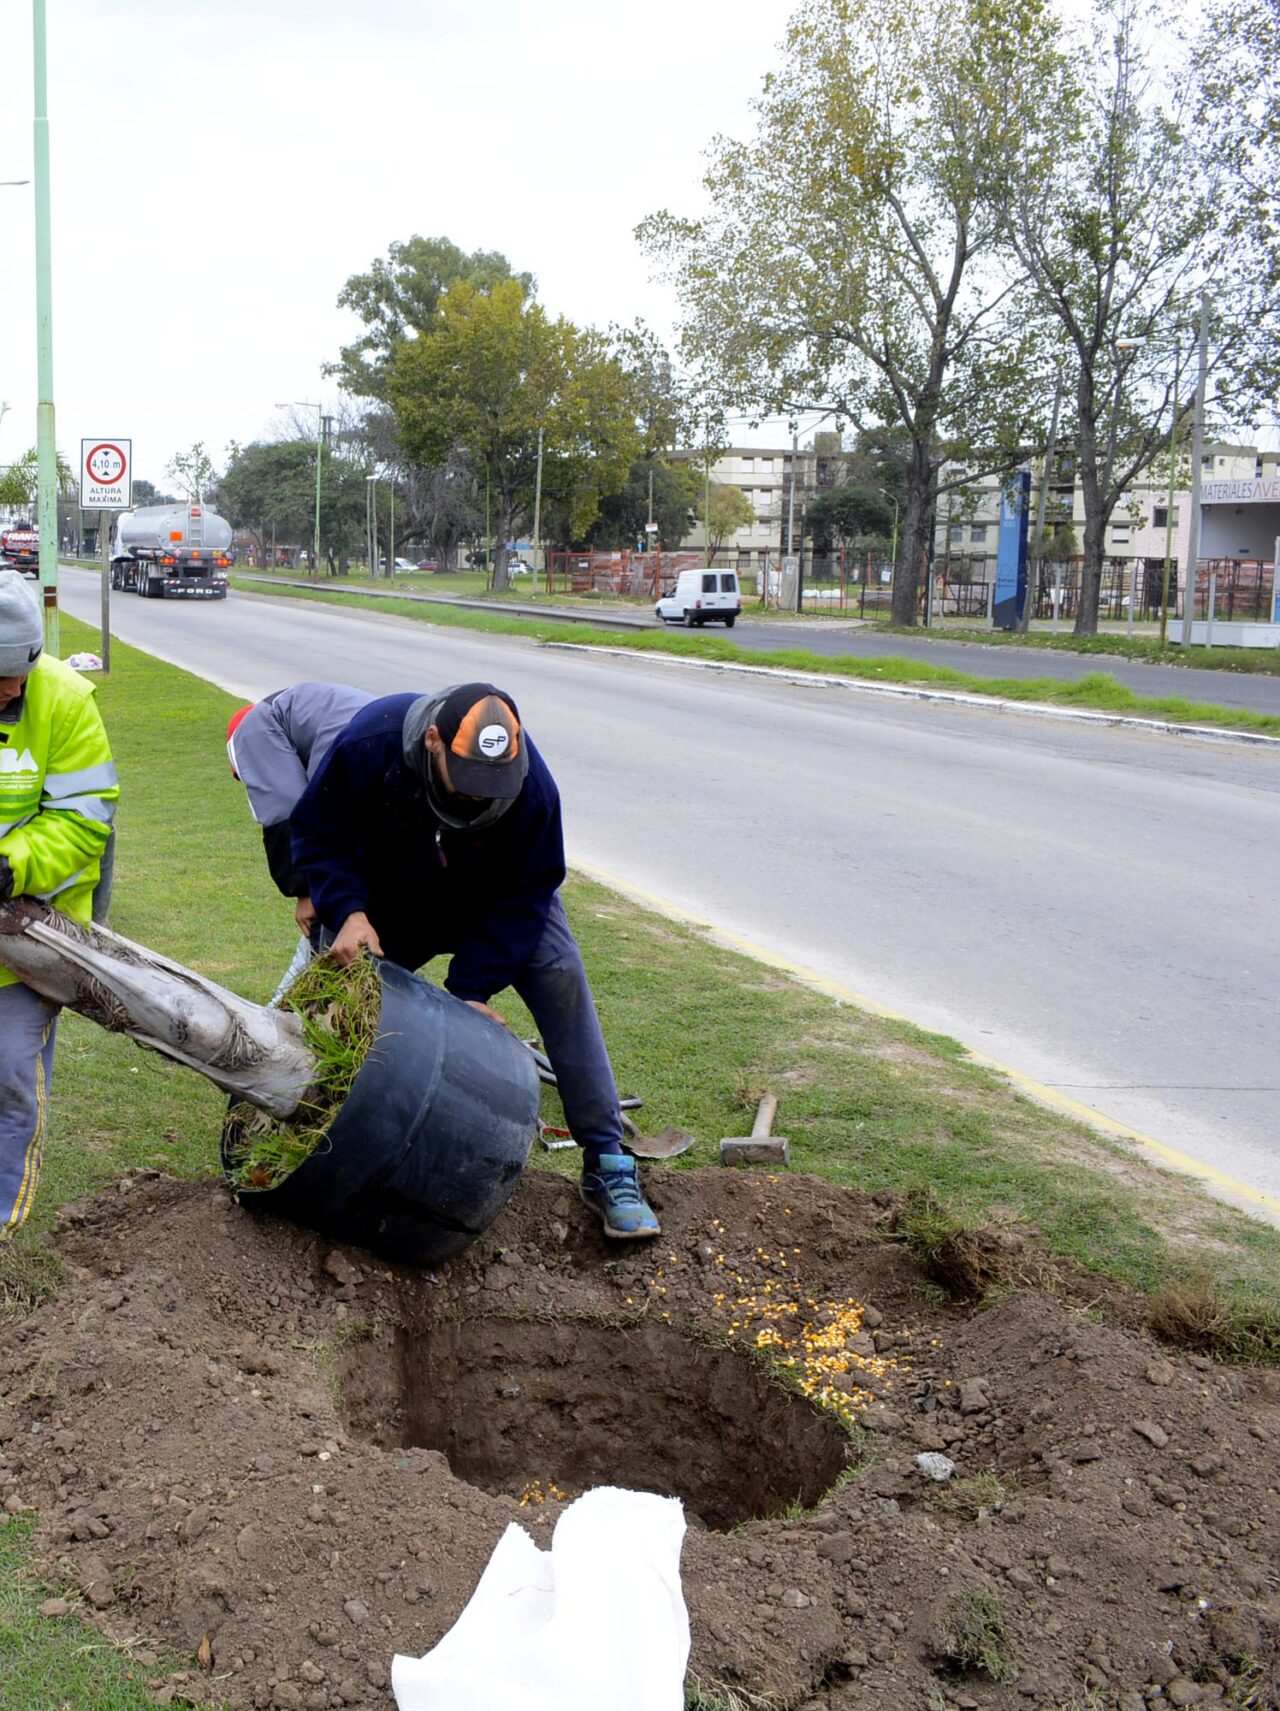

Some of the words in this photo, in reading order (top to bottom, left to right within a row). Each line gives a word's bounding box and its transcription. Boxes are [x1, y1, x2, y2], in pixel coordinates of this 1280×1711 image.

[92, 460, 110, 470] 4,10
[113, 461, 121, 469] m
[90, 487, 122, 495] ALTURA
[1200, 483, 1253, 499] MATERIALES
[7, 532, 40, 541] FRANC
[177, 587, 213, 595] FORD
[0, 747, 39, 774] BA
